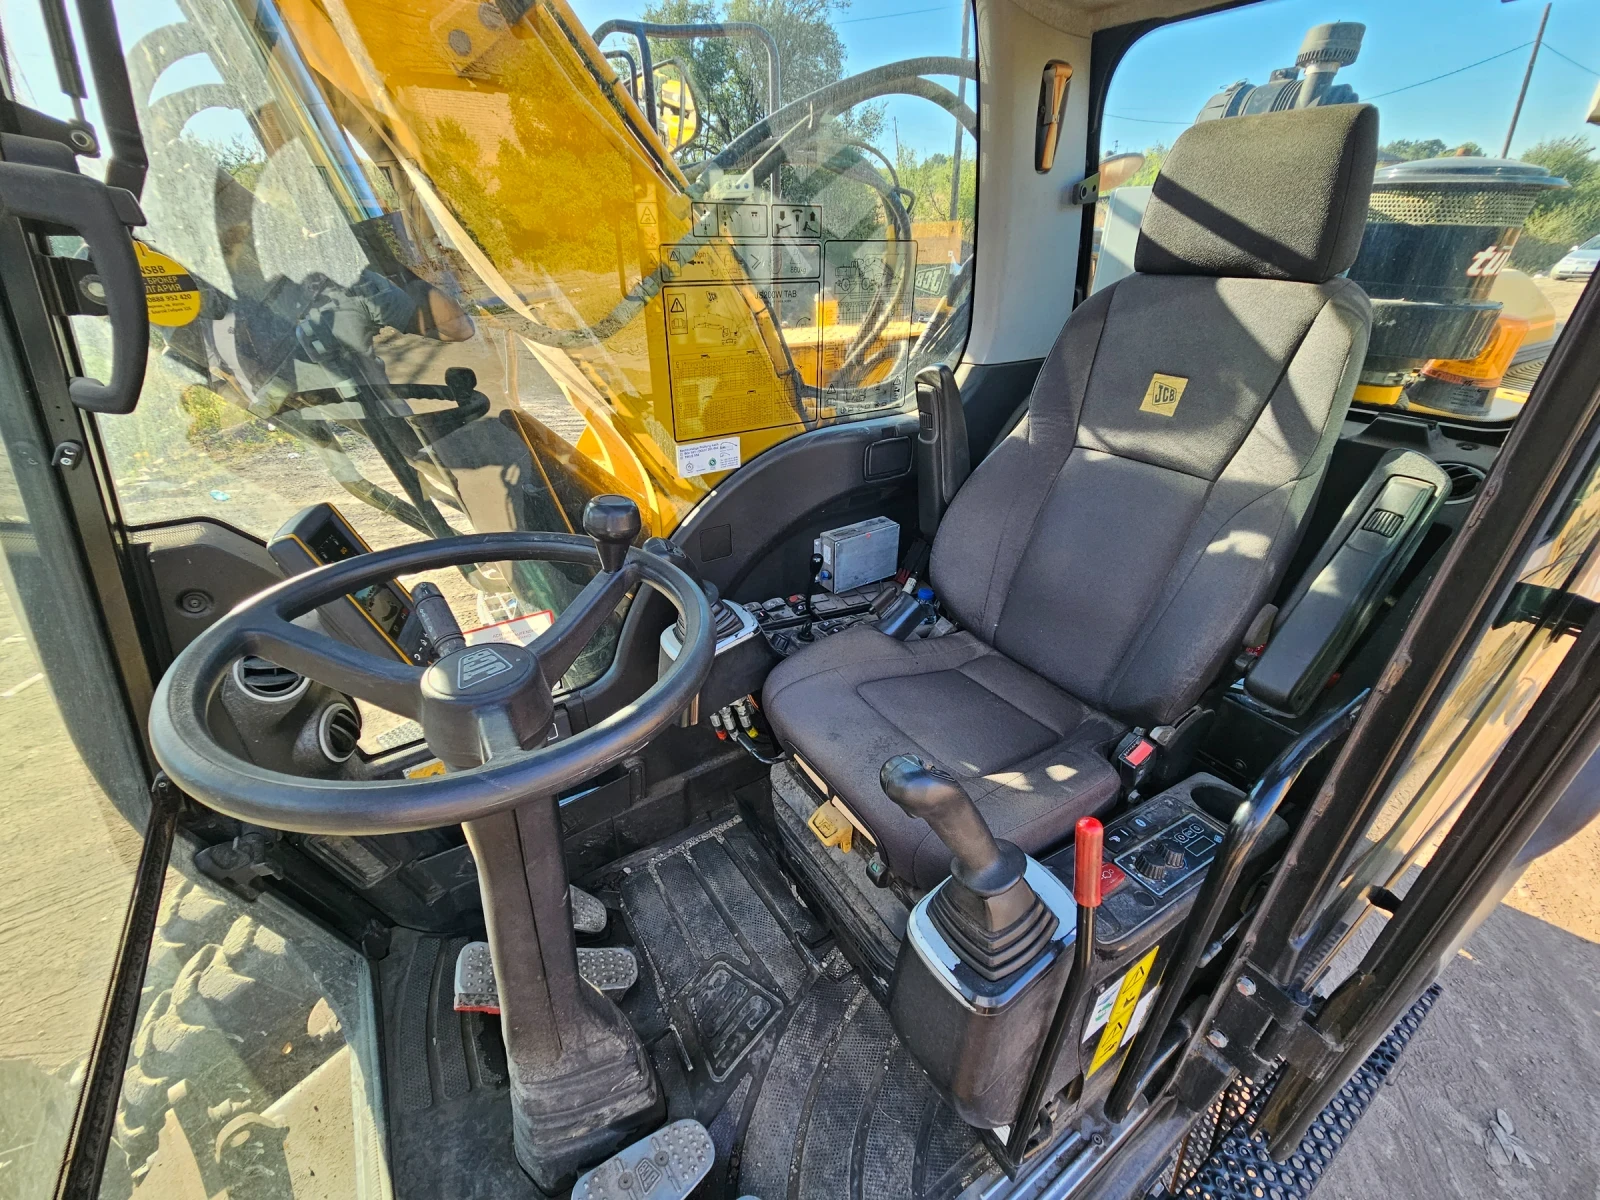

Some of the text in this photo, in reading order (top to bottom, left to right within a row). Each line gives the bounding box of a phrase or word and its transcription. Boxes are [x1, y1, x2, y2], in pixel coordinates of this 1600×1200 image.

[147, 276, 178, 285] БРОКЕР
[784, 289, 798, 298] TAB
[1154, 384, 1176, 403] JCB
[462, 649, 507, 683] JCB
[688, 968, 773, 1059] JCB
